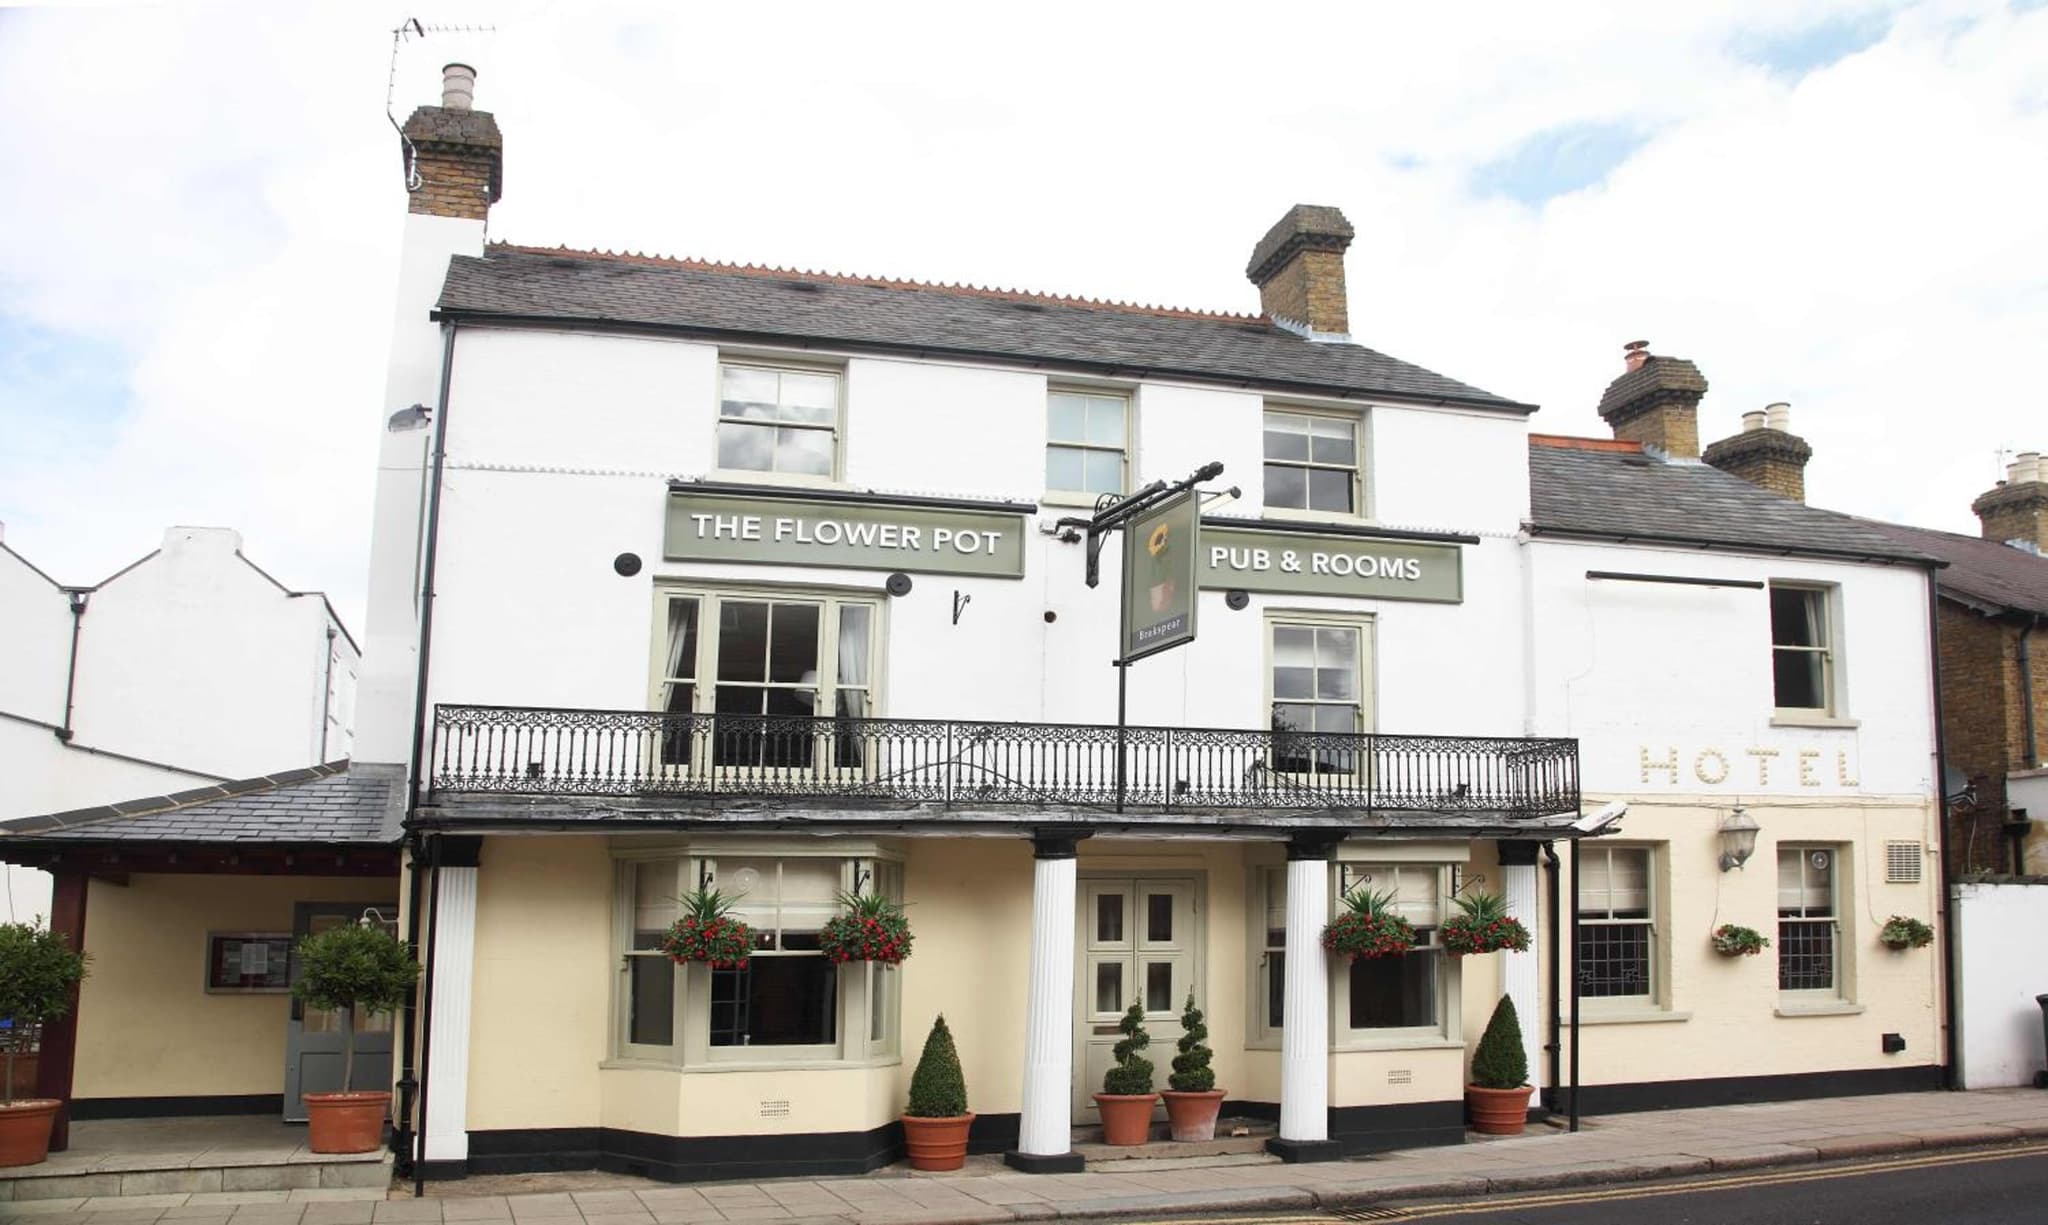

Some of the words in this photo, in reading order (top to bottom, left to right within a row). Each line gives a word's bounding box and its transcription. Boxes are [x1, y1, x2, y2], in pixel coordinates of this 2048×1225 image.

[690, 513, 762, 541] THE
[775, 517, 921, 550] FLOWER
[932, 528, 1003, 555] POT
[1210, 546, 1272, 571] PUB
[1280, 550, 1301, 573] &
[1311, 552, 1422, 581] ROOMS
[1138, 618, 1181, 641] Brakspear
[1639, 745, 1860, 787] HOTEL
